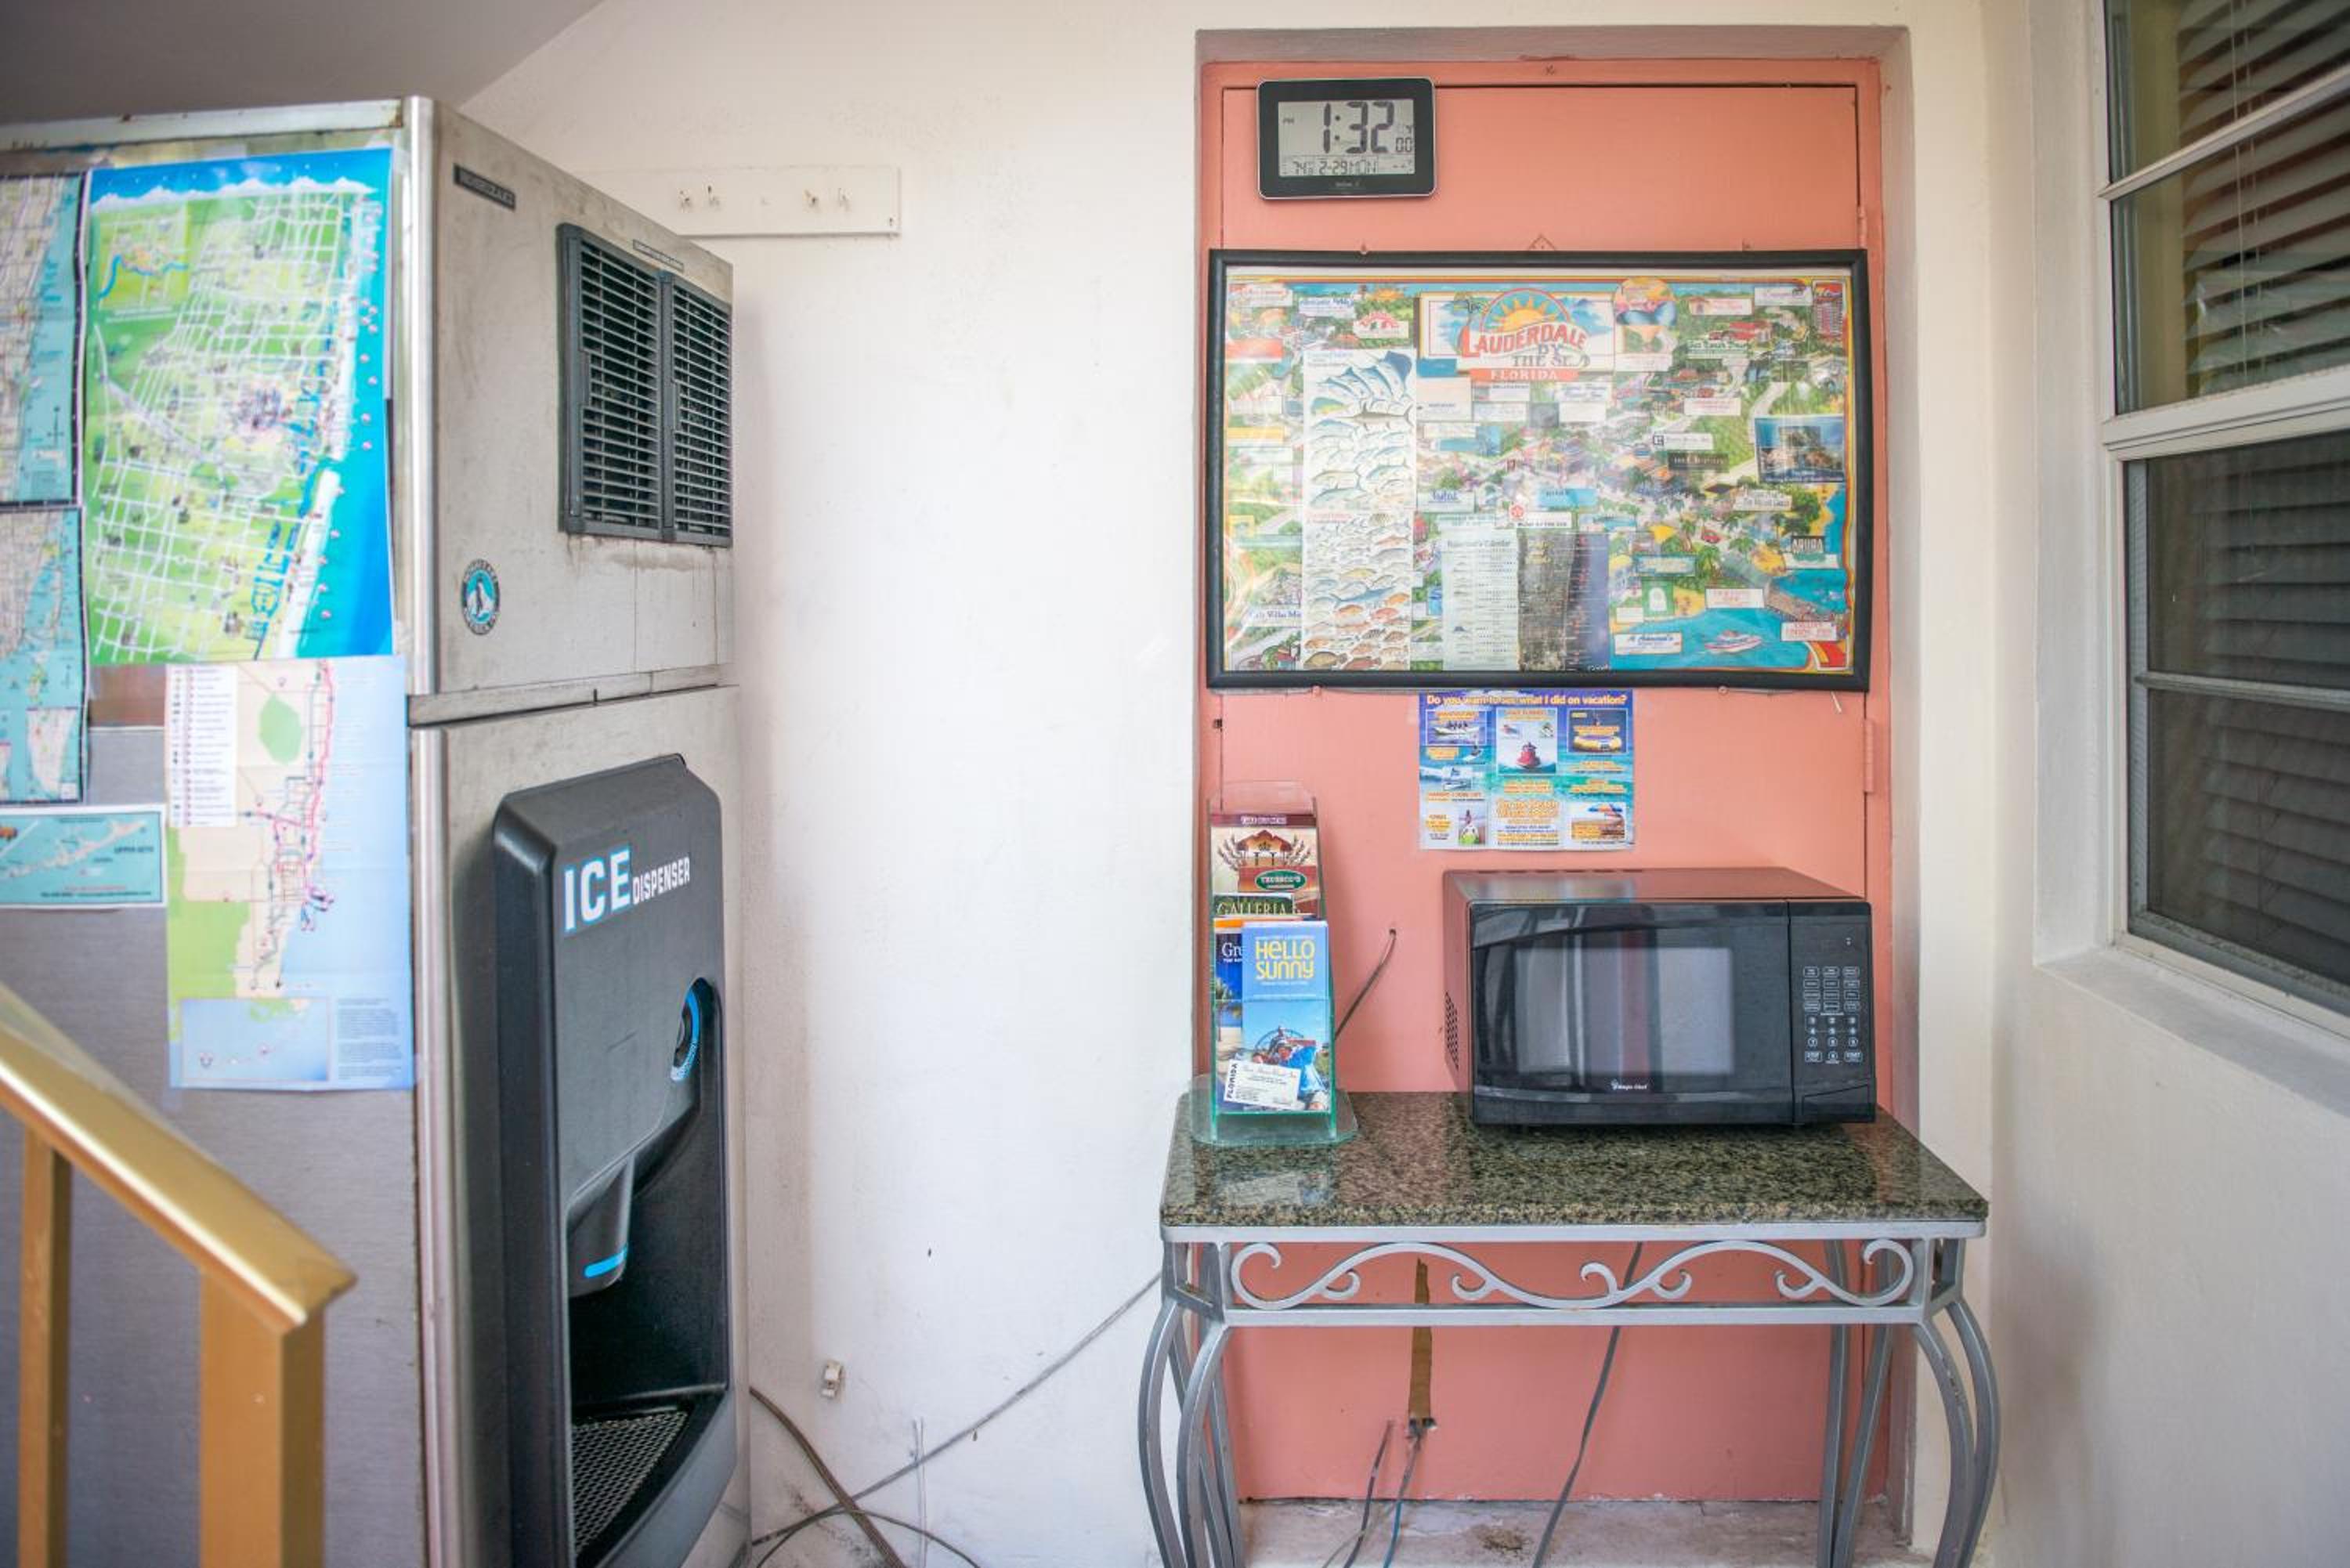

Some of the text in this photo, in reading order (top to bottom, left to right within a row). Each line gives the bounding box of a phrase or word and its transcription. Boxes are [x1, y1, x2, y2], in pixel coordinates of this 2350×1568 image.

[1323, 101, 1394, 154] 1:32
[1461, 322, 1588, 358] LAUDERDALE
[1491, 369, 1557, 380] FLORIDA
[1427, 695, 1441, 704] Do
[563, 847, 691, 933] ICE DISPENSER
